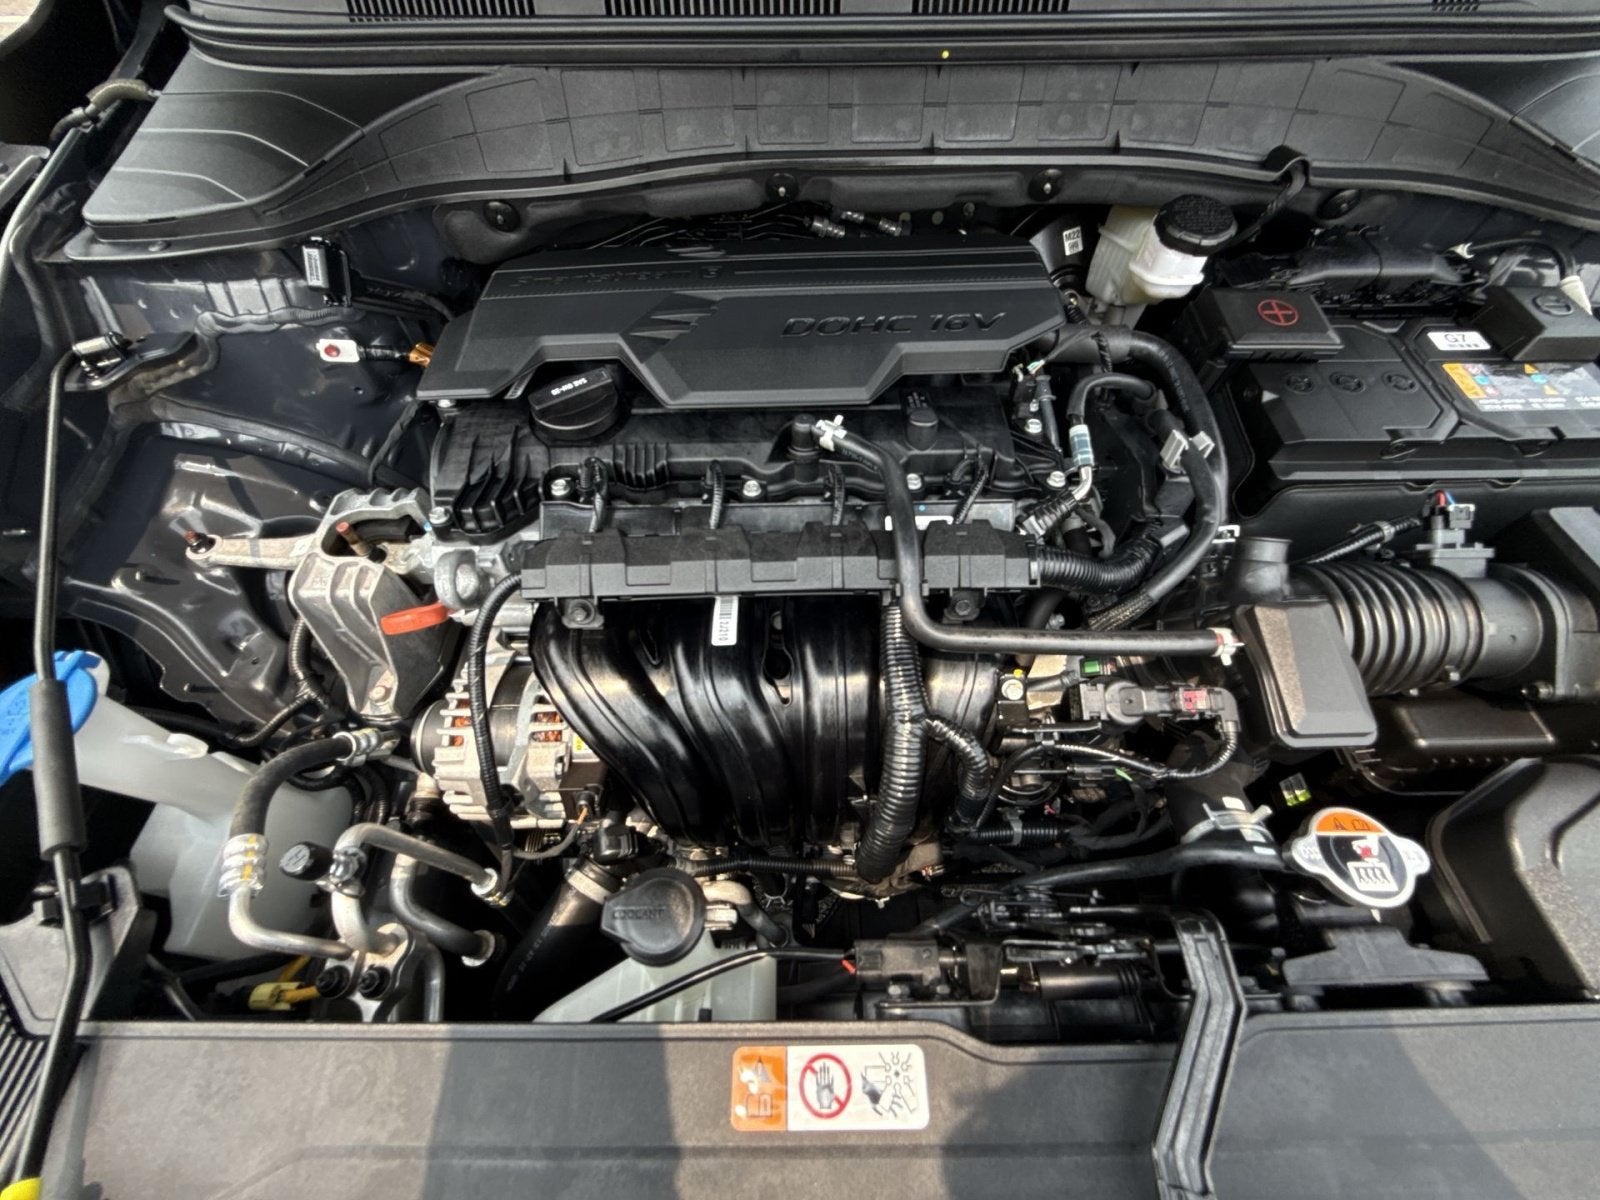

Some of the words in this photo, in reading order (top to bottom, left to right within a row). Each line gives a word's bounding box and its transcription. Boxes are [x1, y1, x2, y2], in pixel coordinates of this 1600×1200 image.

[1065, 230, 1080, 242] M22
[781, 316, 918, 336] DOHC
[929, 311, 1006, 332] 16V
[1443, 333, 1466, 343] G7
[611, 907, 666, 920] COOLANT
